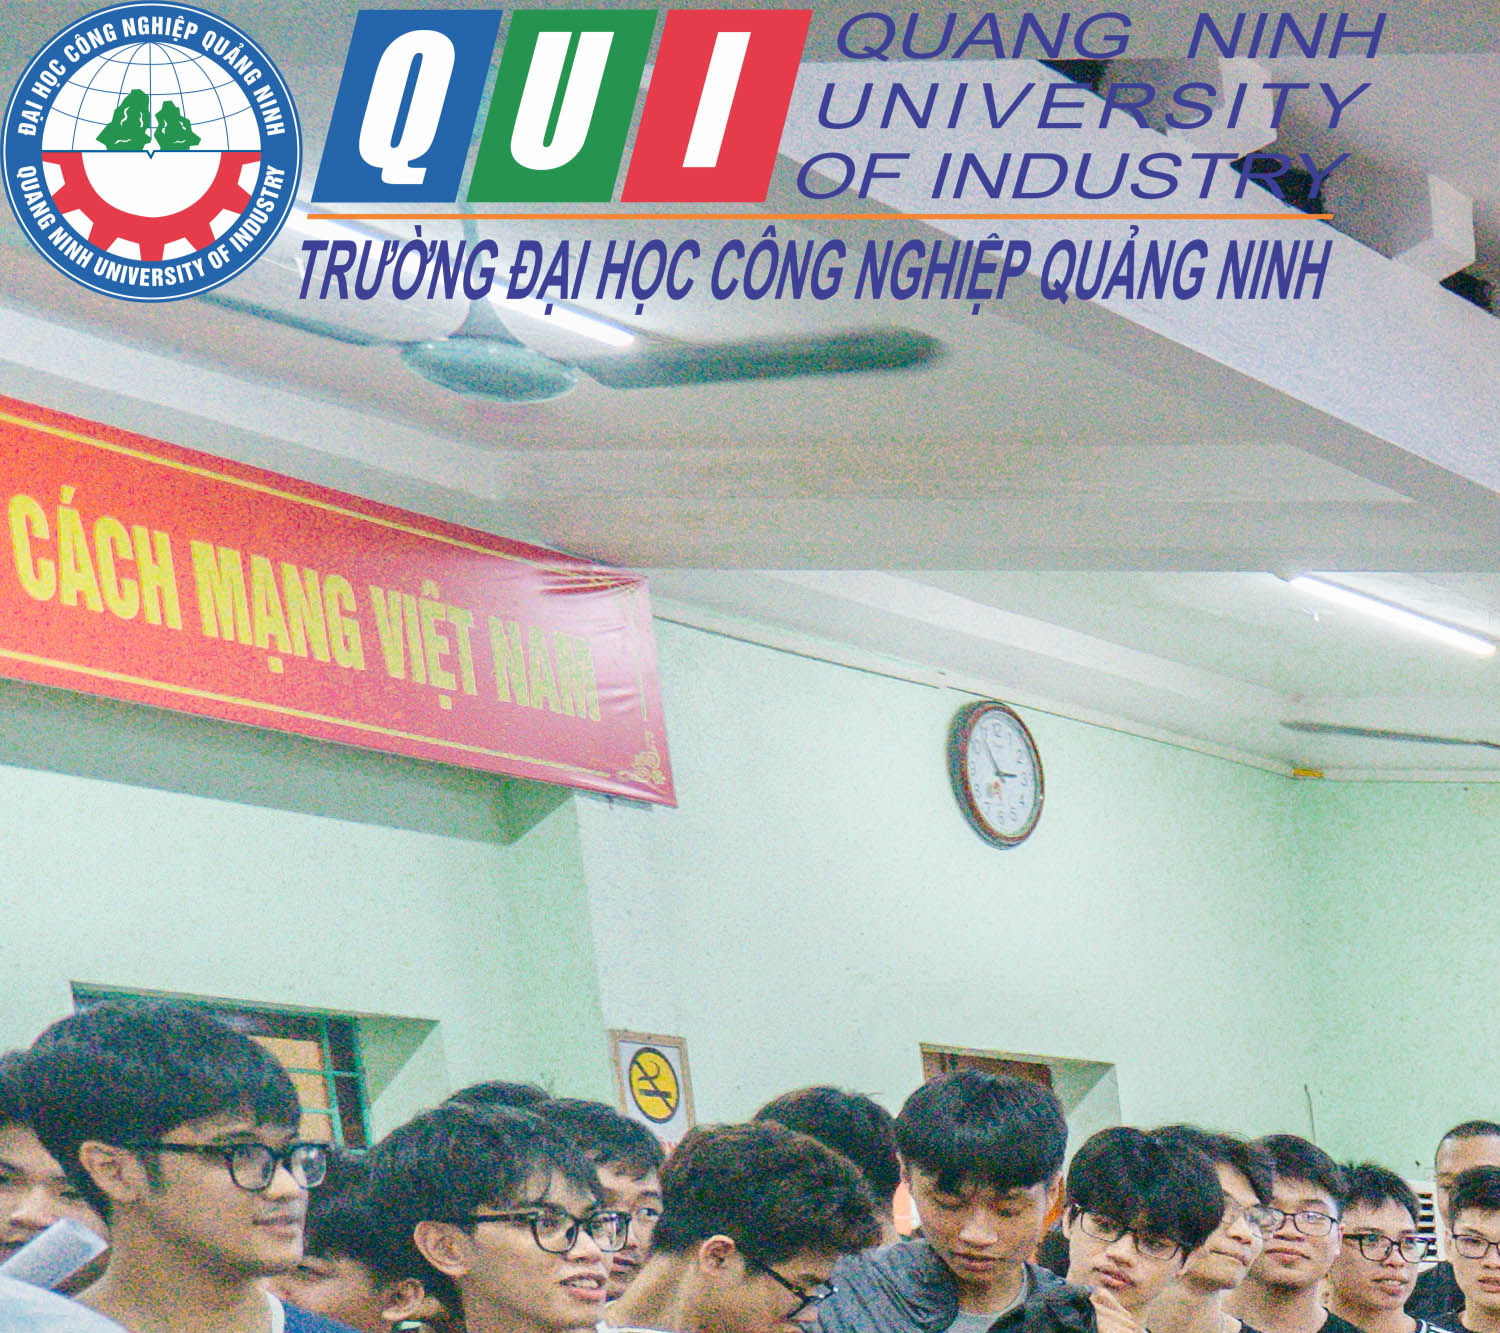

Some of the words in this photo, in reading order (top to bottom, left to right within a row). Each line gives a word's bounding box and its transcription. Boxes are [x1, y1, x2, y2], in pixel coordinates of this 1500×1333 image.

[8, 485, 183, 631] CÁCH
[190, 539, 365, 674] MẠNG
[370, 581, 478, 710] VIỆT
[488, 616, 603, 723] NAM
